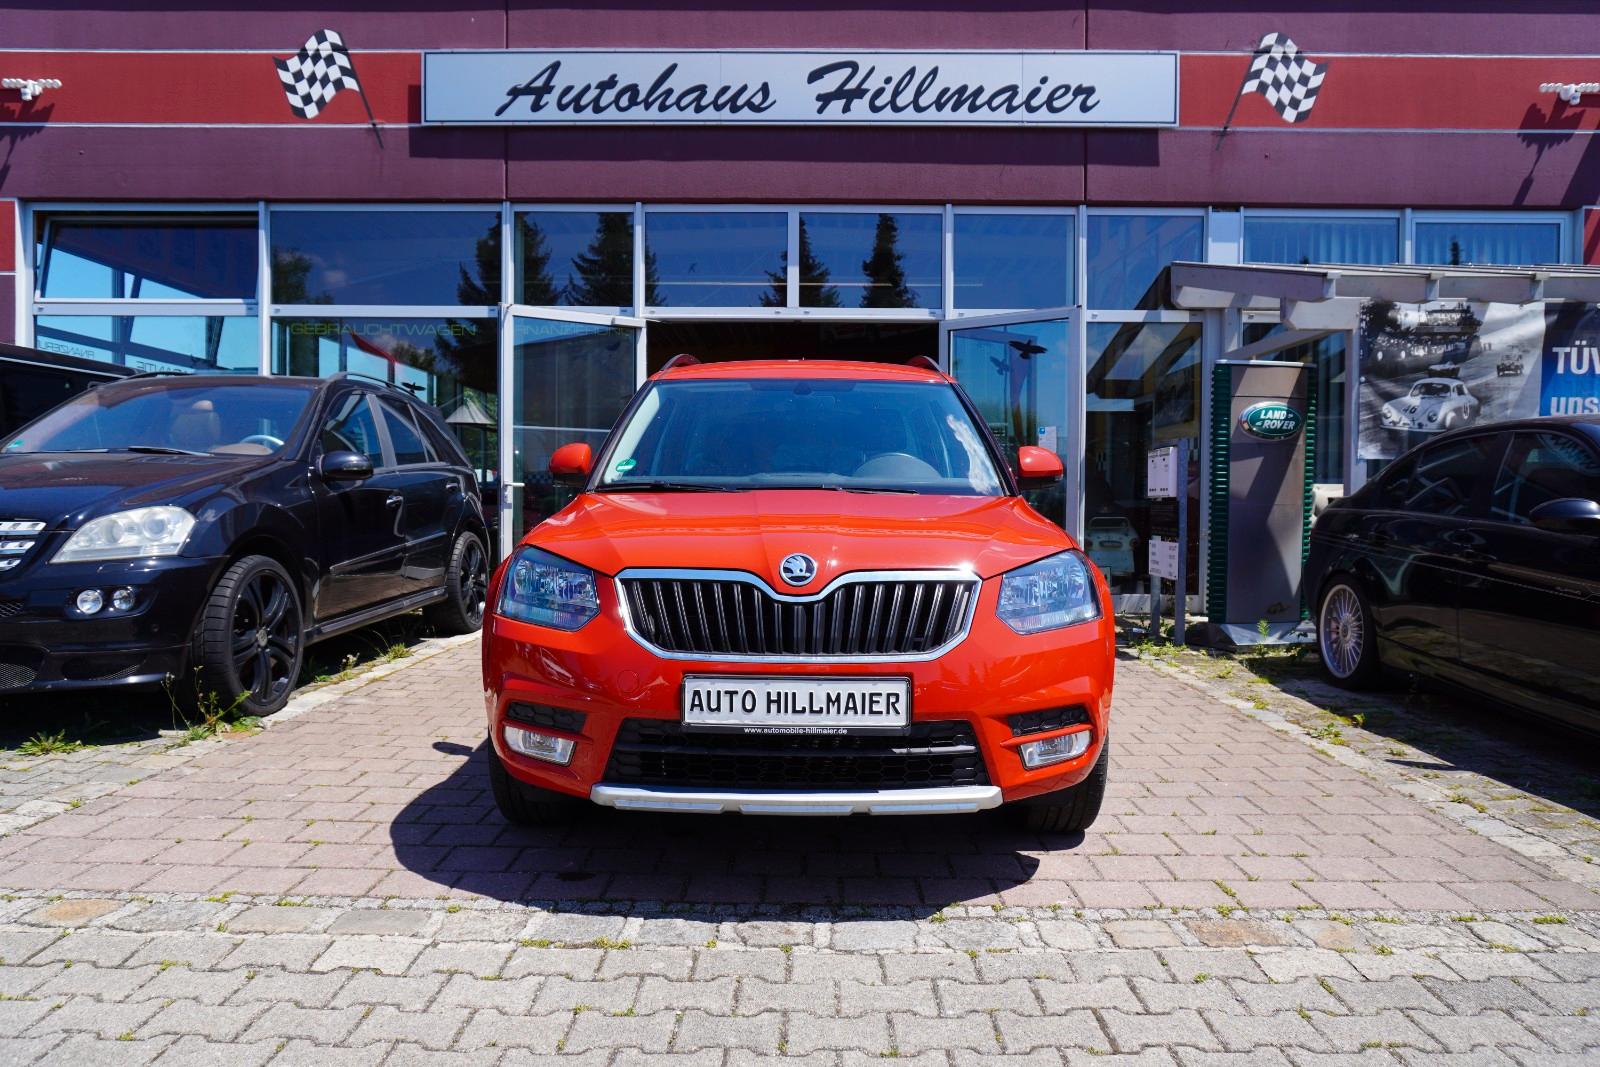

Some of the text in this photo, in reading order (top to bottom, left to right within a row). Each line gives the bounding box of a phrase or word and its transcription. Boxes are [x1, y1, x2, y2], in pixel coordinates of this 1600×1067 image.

[495, 60, 1101, 117] Autohaus Hillmaier
[290, 323, 478, 336] GEBRAUCHTWAGEN
[1260, 409, 1287, 420] LAND
[1262, 420, 1296, 430] ROVER
[690, 689, 901, 715] AUTO HILLMAIER
[743, 726, 848, 735] www.automobile-hillmaier.de
